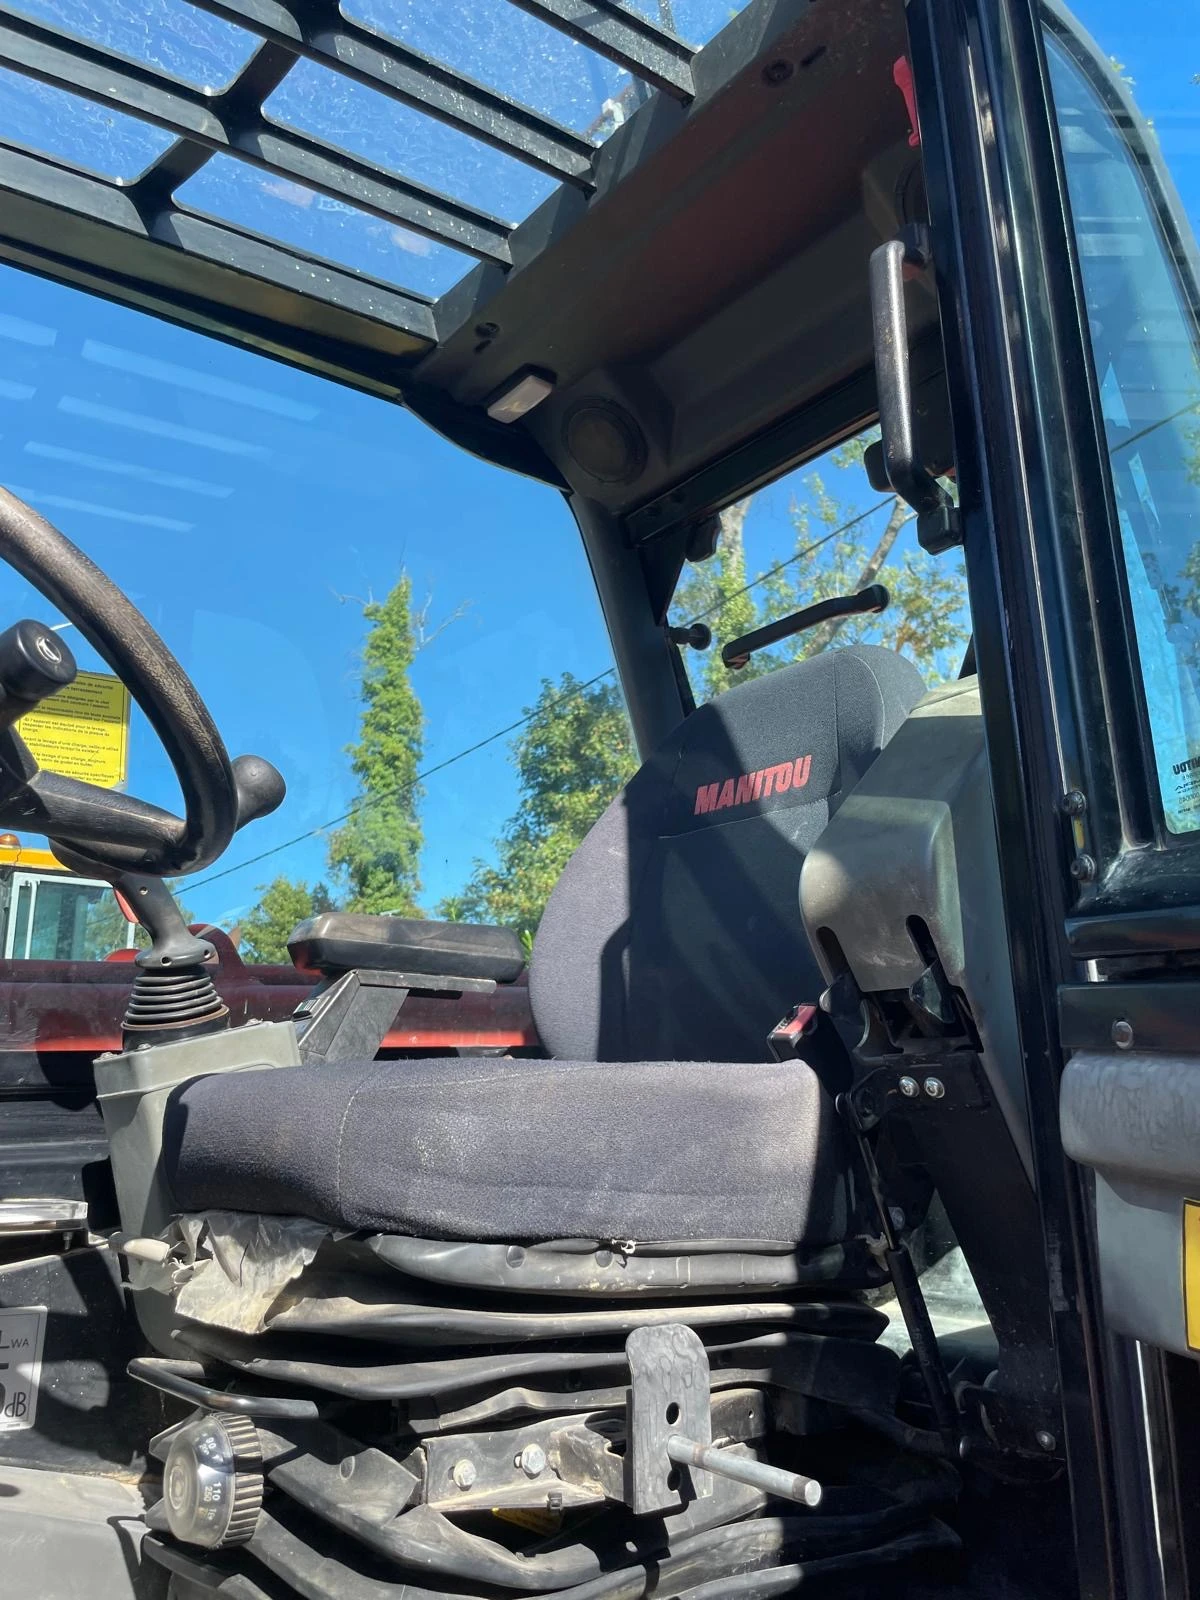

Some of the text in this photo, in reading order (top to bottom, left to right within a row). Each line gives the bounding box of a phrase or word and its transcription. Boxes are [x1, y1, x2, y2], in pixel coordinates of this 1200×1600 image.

[694, 754, 812, 815] MANITOU
[203, 1486, 213, 1502] 250
[212, 1481, 222, 1501] 110
